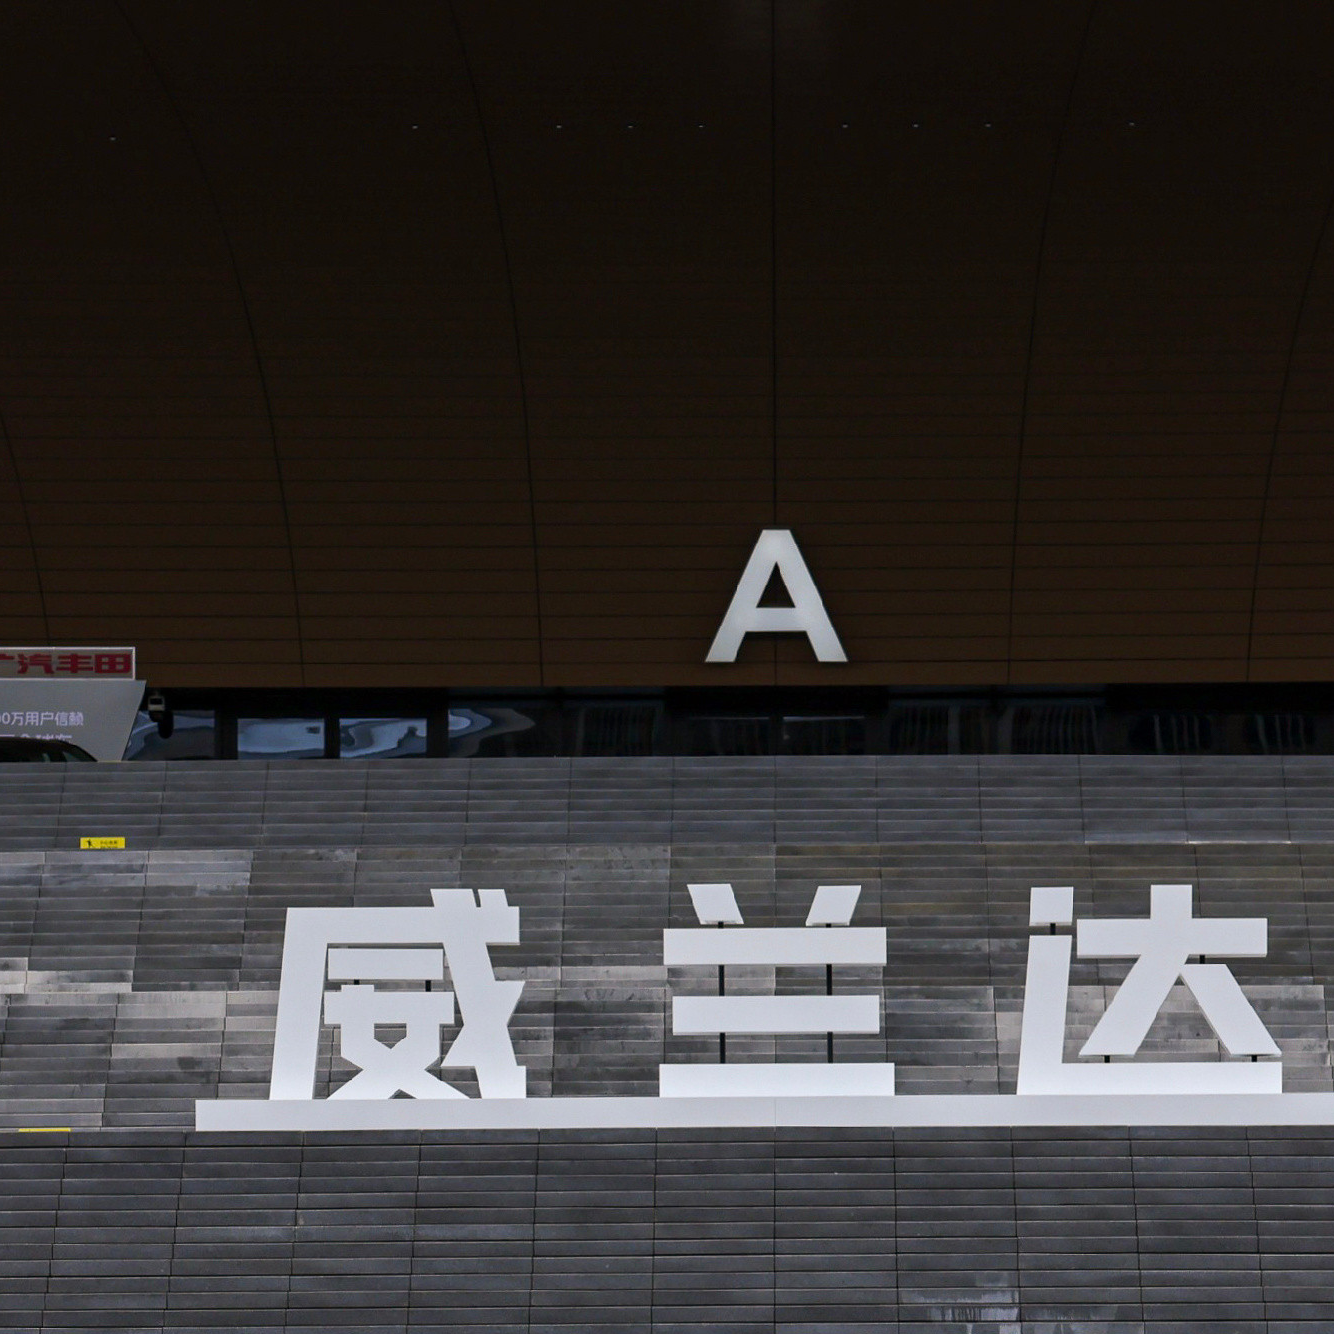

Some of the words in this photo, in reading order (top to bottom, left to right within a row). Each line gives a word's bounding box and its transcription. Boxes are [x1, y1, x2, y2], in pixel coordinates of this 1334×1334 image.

[705, 529, 848, 662] A
[269, 884, 1282, 1100] 威兰达
